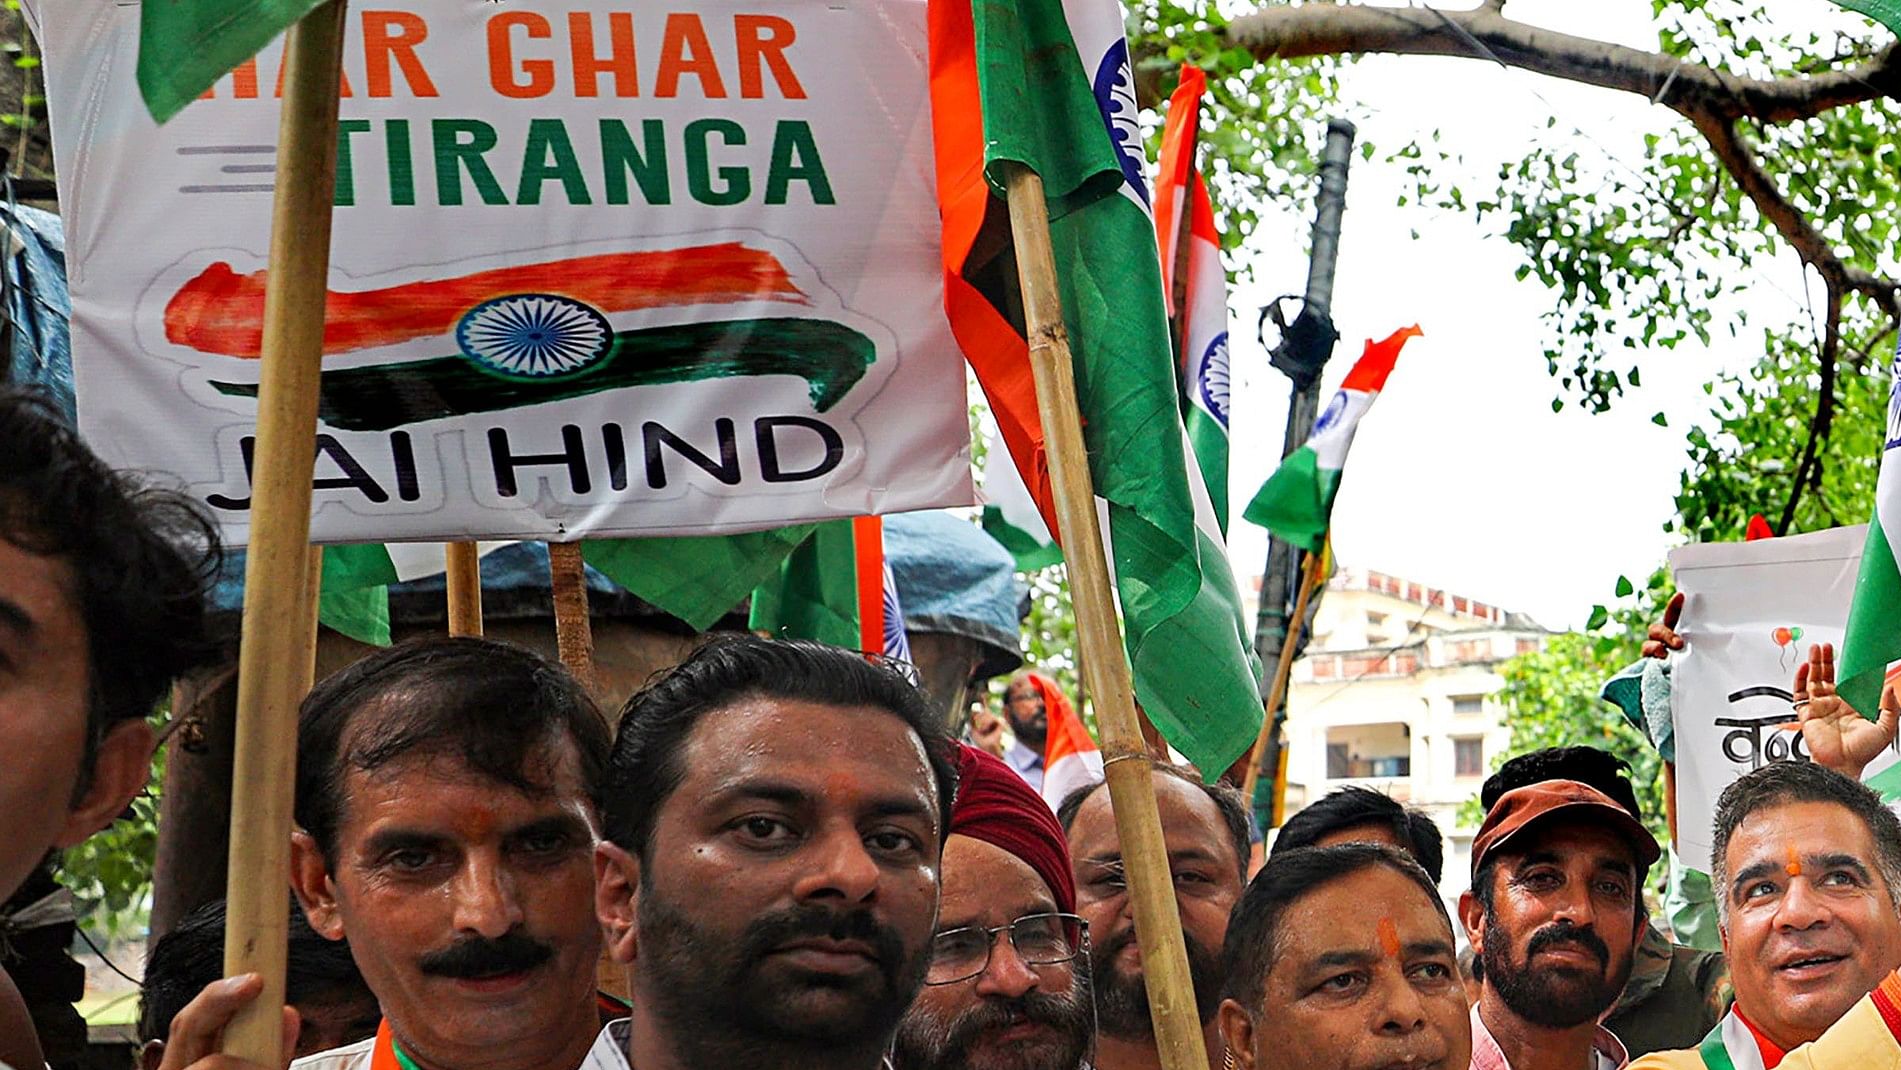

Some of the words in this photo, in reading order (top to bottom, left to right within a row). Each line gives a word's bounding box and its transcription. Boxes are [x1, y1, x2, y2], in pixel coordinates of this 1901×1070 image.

[486, 11, 808, 100] GHAR
[333, 119, 836, 207] TIRANGA
[488, 416, 845, 497] HIND
